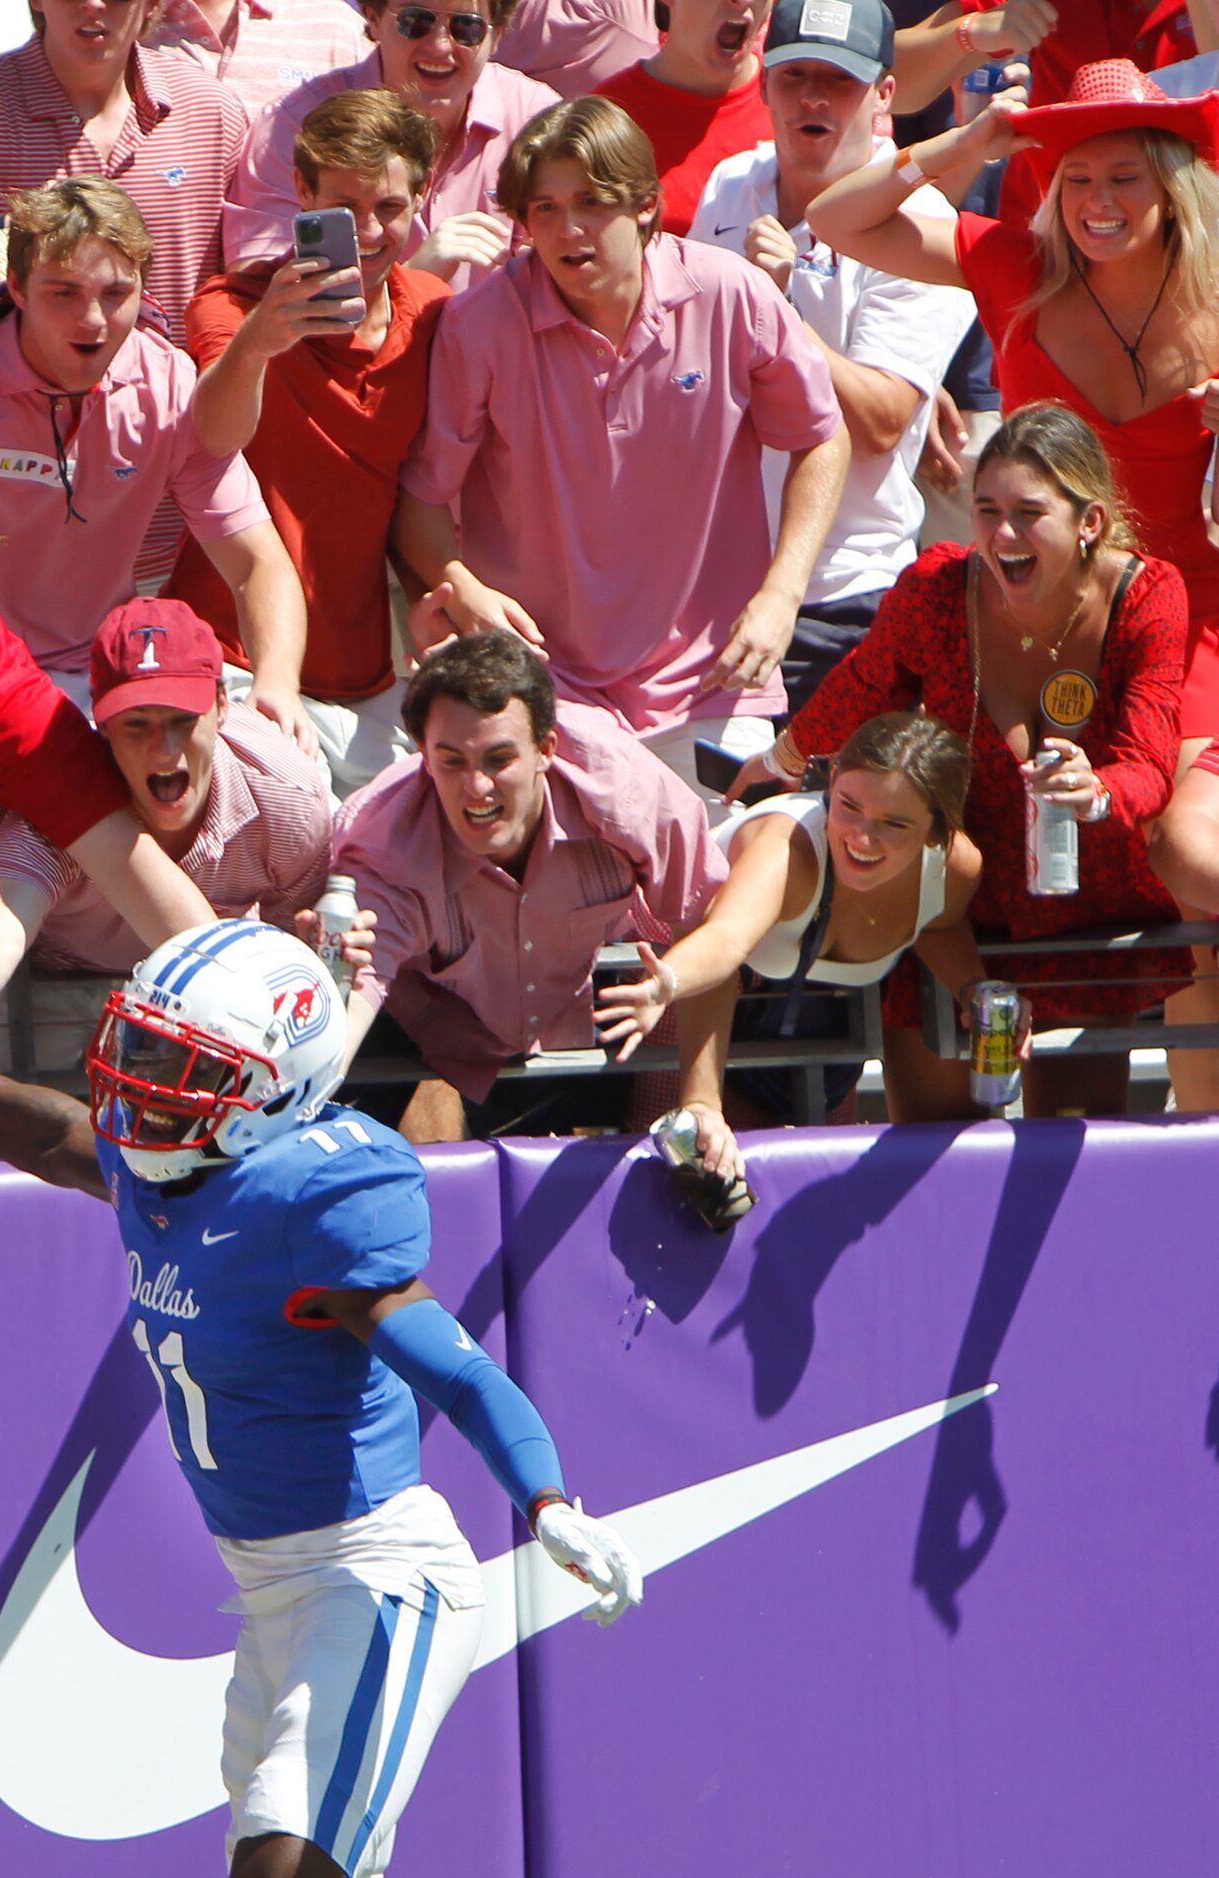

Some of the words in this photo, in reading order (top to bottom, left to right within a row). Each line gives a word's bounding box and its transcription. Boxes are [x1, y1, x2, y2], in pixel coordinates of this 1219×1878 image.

[1052, 679, 1087, 700] THINK
[1051, 697, 1085, 717] THETA
[148, 990, 171, 1009] 214
[128, 1250, 201, 1320] Dallas
[131, 1317, 220, 1471] 11
